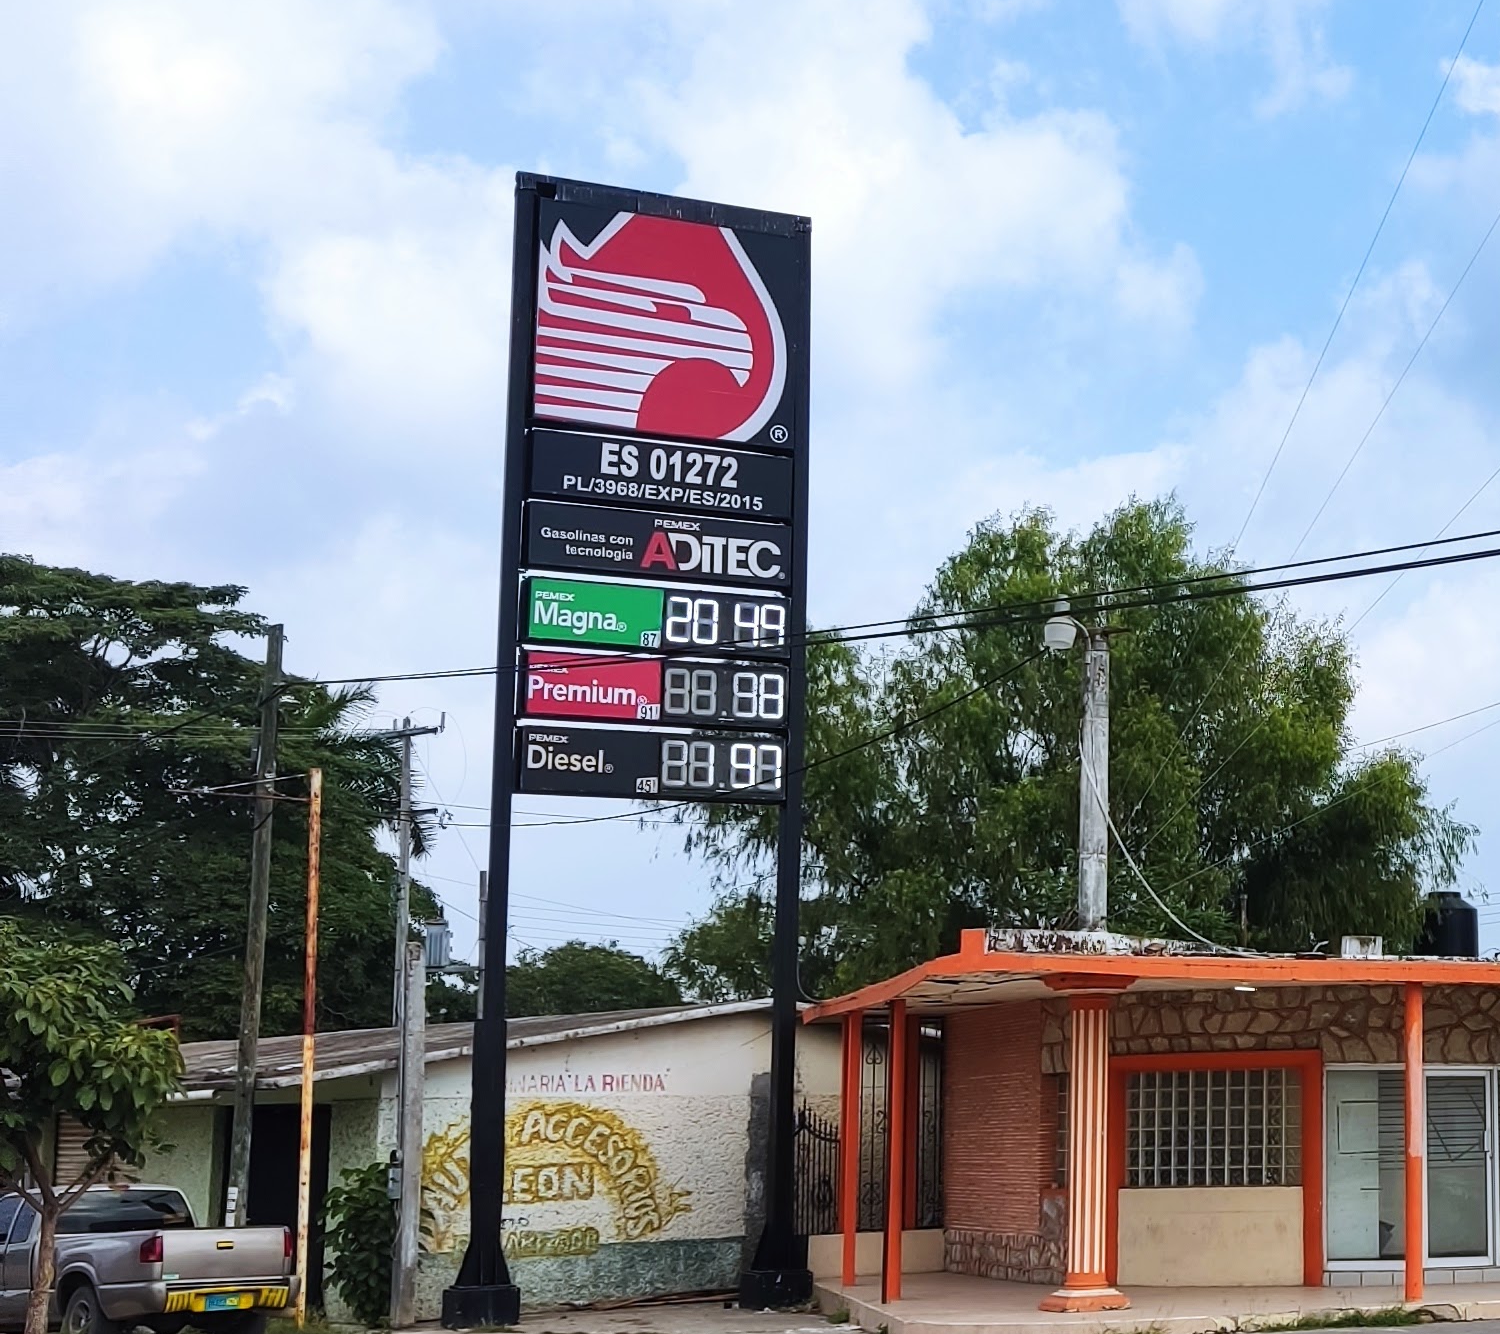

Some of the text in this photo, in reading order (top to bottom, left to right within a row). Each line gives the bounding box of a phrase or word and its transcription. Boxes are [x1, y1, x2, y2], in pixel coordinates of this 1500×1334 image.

[600, 442, 738, 489] ES 01272
[563, 475, 763, 511] PL/3968/EXP/ES/2015
[654, 519, 700, 531] PEMEX
[540, 527, 634, 546] Gasolinas con
[535, 591, 575, 601] PEMEX
[641, 633, 657, 647] 87
[528, 733, 568, 743] PEMEX
